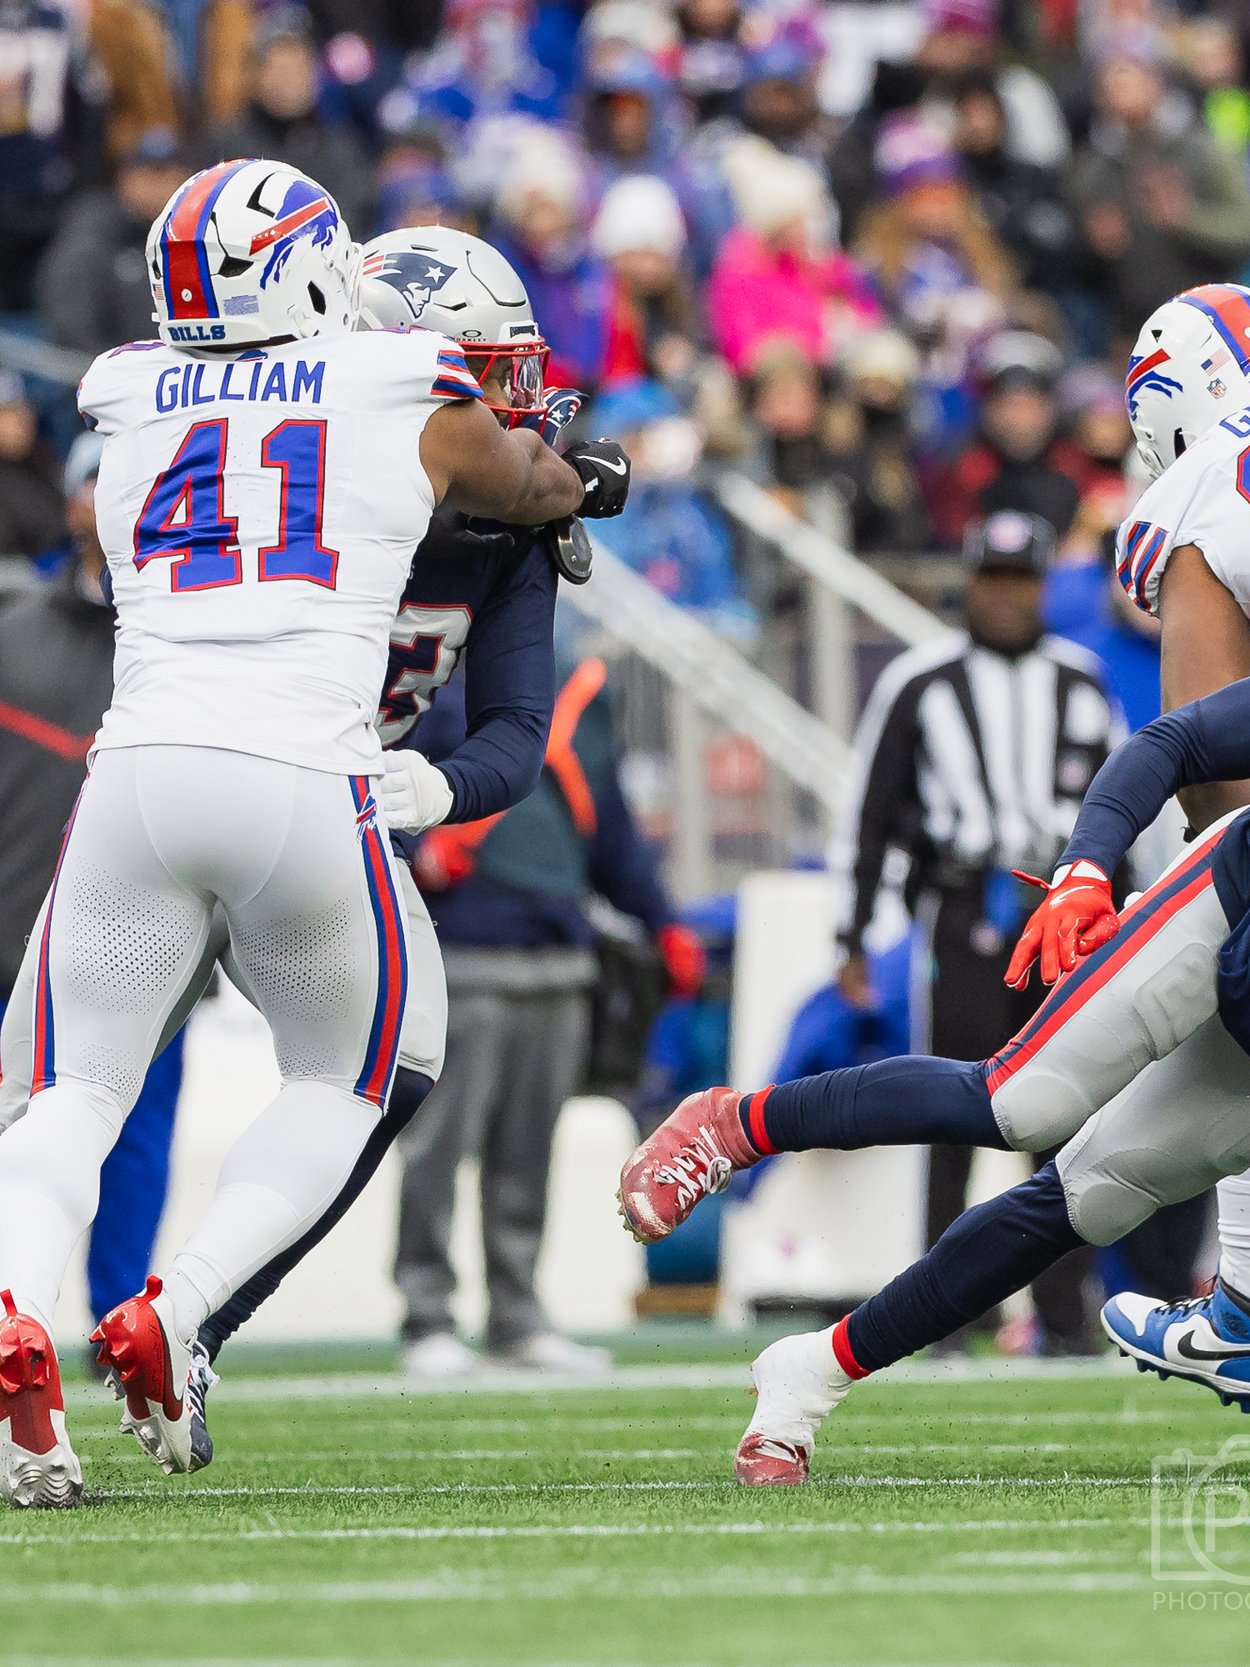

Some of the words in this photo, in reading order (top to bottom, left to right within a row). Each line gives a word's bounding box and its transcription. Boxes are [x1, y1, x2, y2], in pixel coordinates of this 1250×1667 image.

[167, 324, 226, 342] BILLS
[156, 360, 327, 414] GILLIAM
[132, 416, 341, 593] 41
